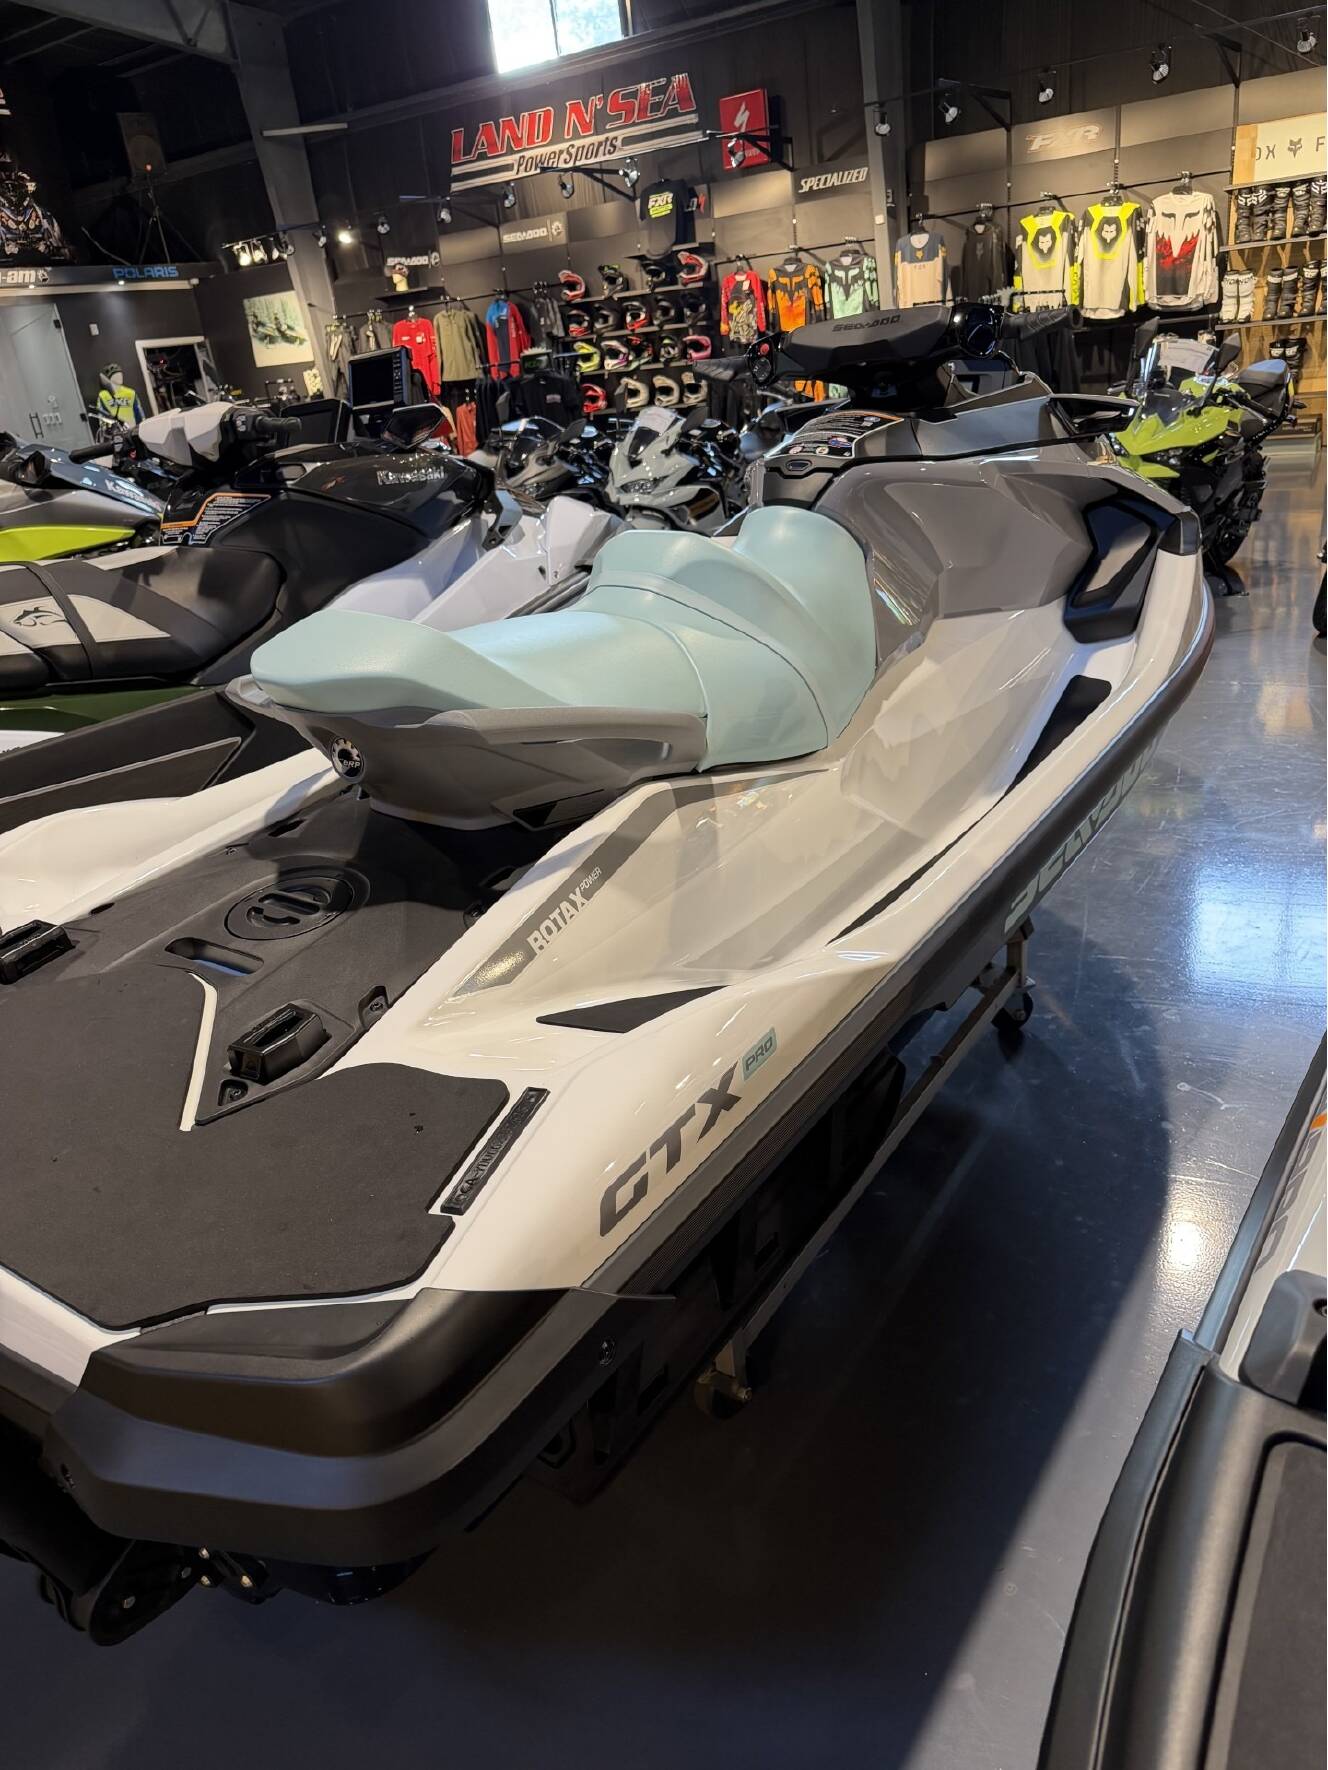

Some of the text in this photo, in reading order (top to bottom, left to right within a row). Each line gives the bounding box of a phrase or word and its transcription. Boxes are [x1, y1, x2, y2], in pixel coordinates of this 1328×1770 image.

[451, 106, 554, 164] LAND
[515, 134, 620, 176] PowerSports
[798, 166, 870, 194] SPECIALIZED
[0, 266, 179, 284] -am POLARIS
[831, 315, 901, 333] SEA-DOO
[376, 465, 446, 486] Kawasaki
[526, 866, 602, 956] ROTAX POWER
[599, 1035, 774, 1238] GTX PRO
